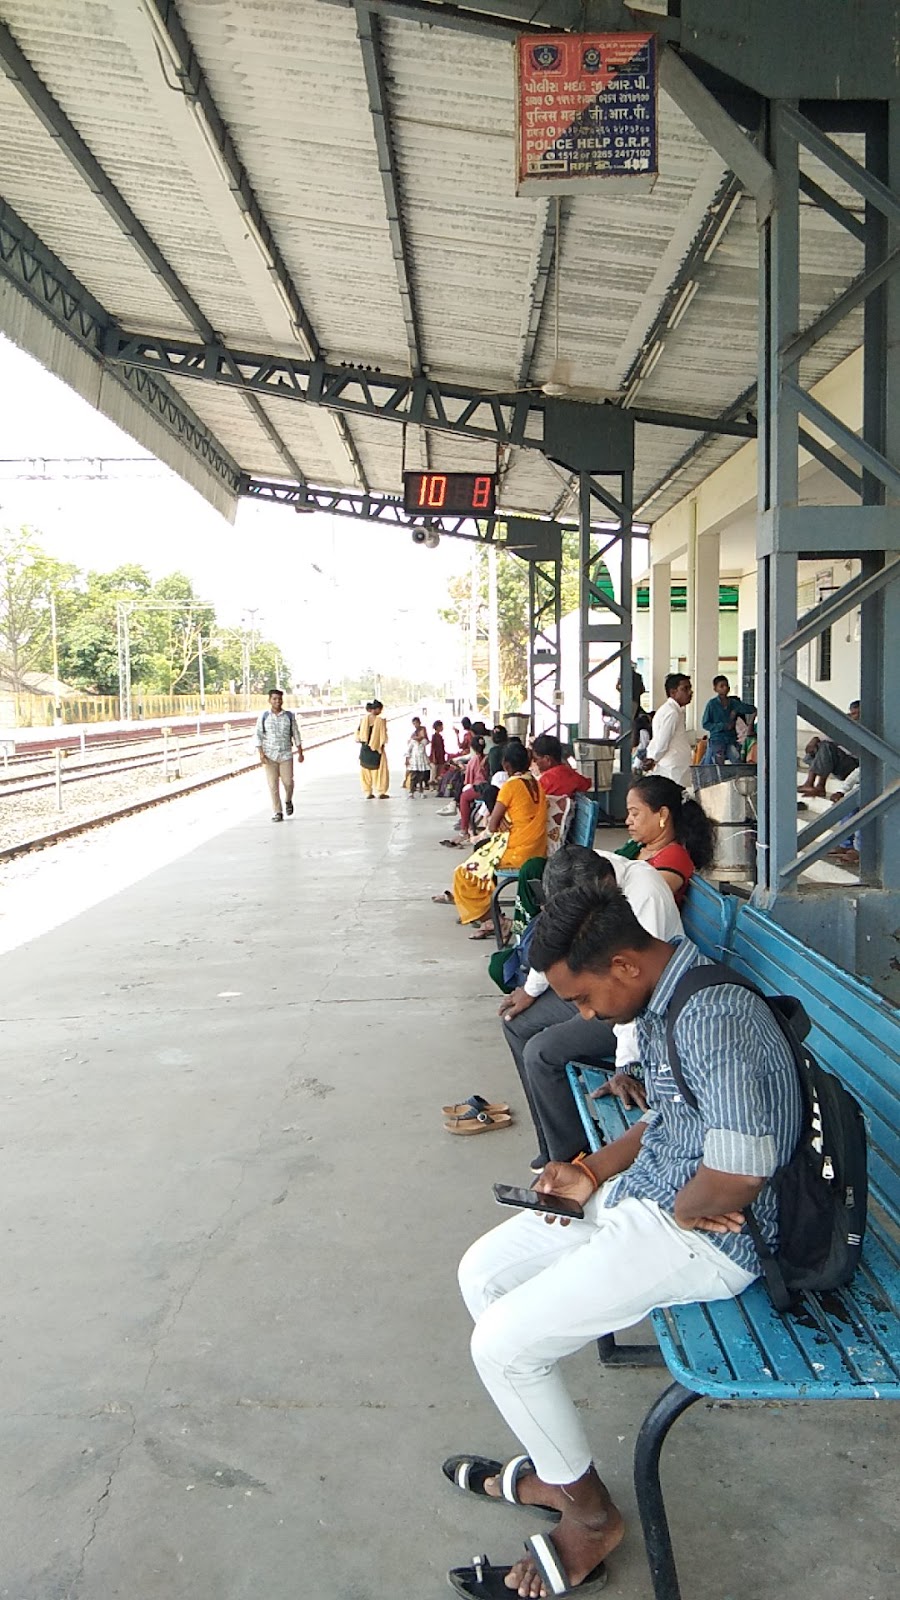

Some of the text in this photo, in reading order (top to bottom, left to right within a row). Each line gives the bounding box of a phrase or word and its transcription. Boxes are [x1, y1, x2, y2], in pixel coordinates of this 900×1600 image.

[525, 78, 558, 93] પોલીસ
[525, 107, 557, 127] पुलिस
[526, 136, 651, 151] POLICE HELP G.R.P.
[558, 151, 578, 160] 1512
[591, 150, 612, 159] 0265
[614, 149, 651, 158] 2417100
[570, 162, 592, 171] RPF
